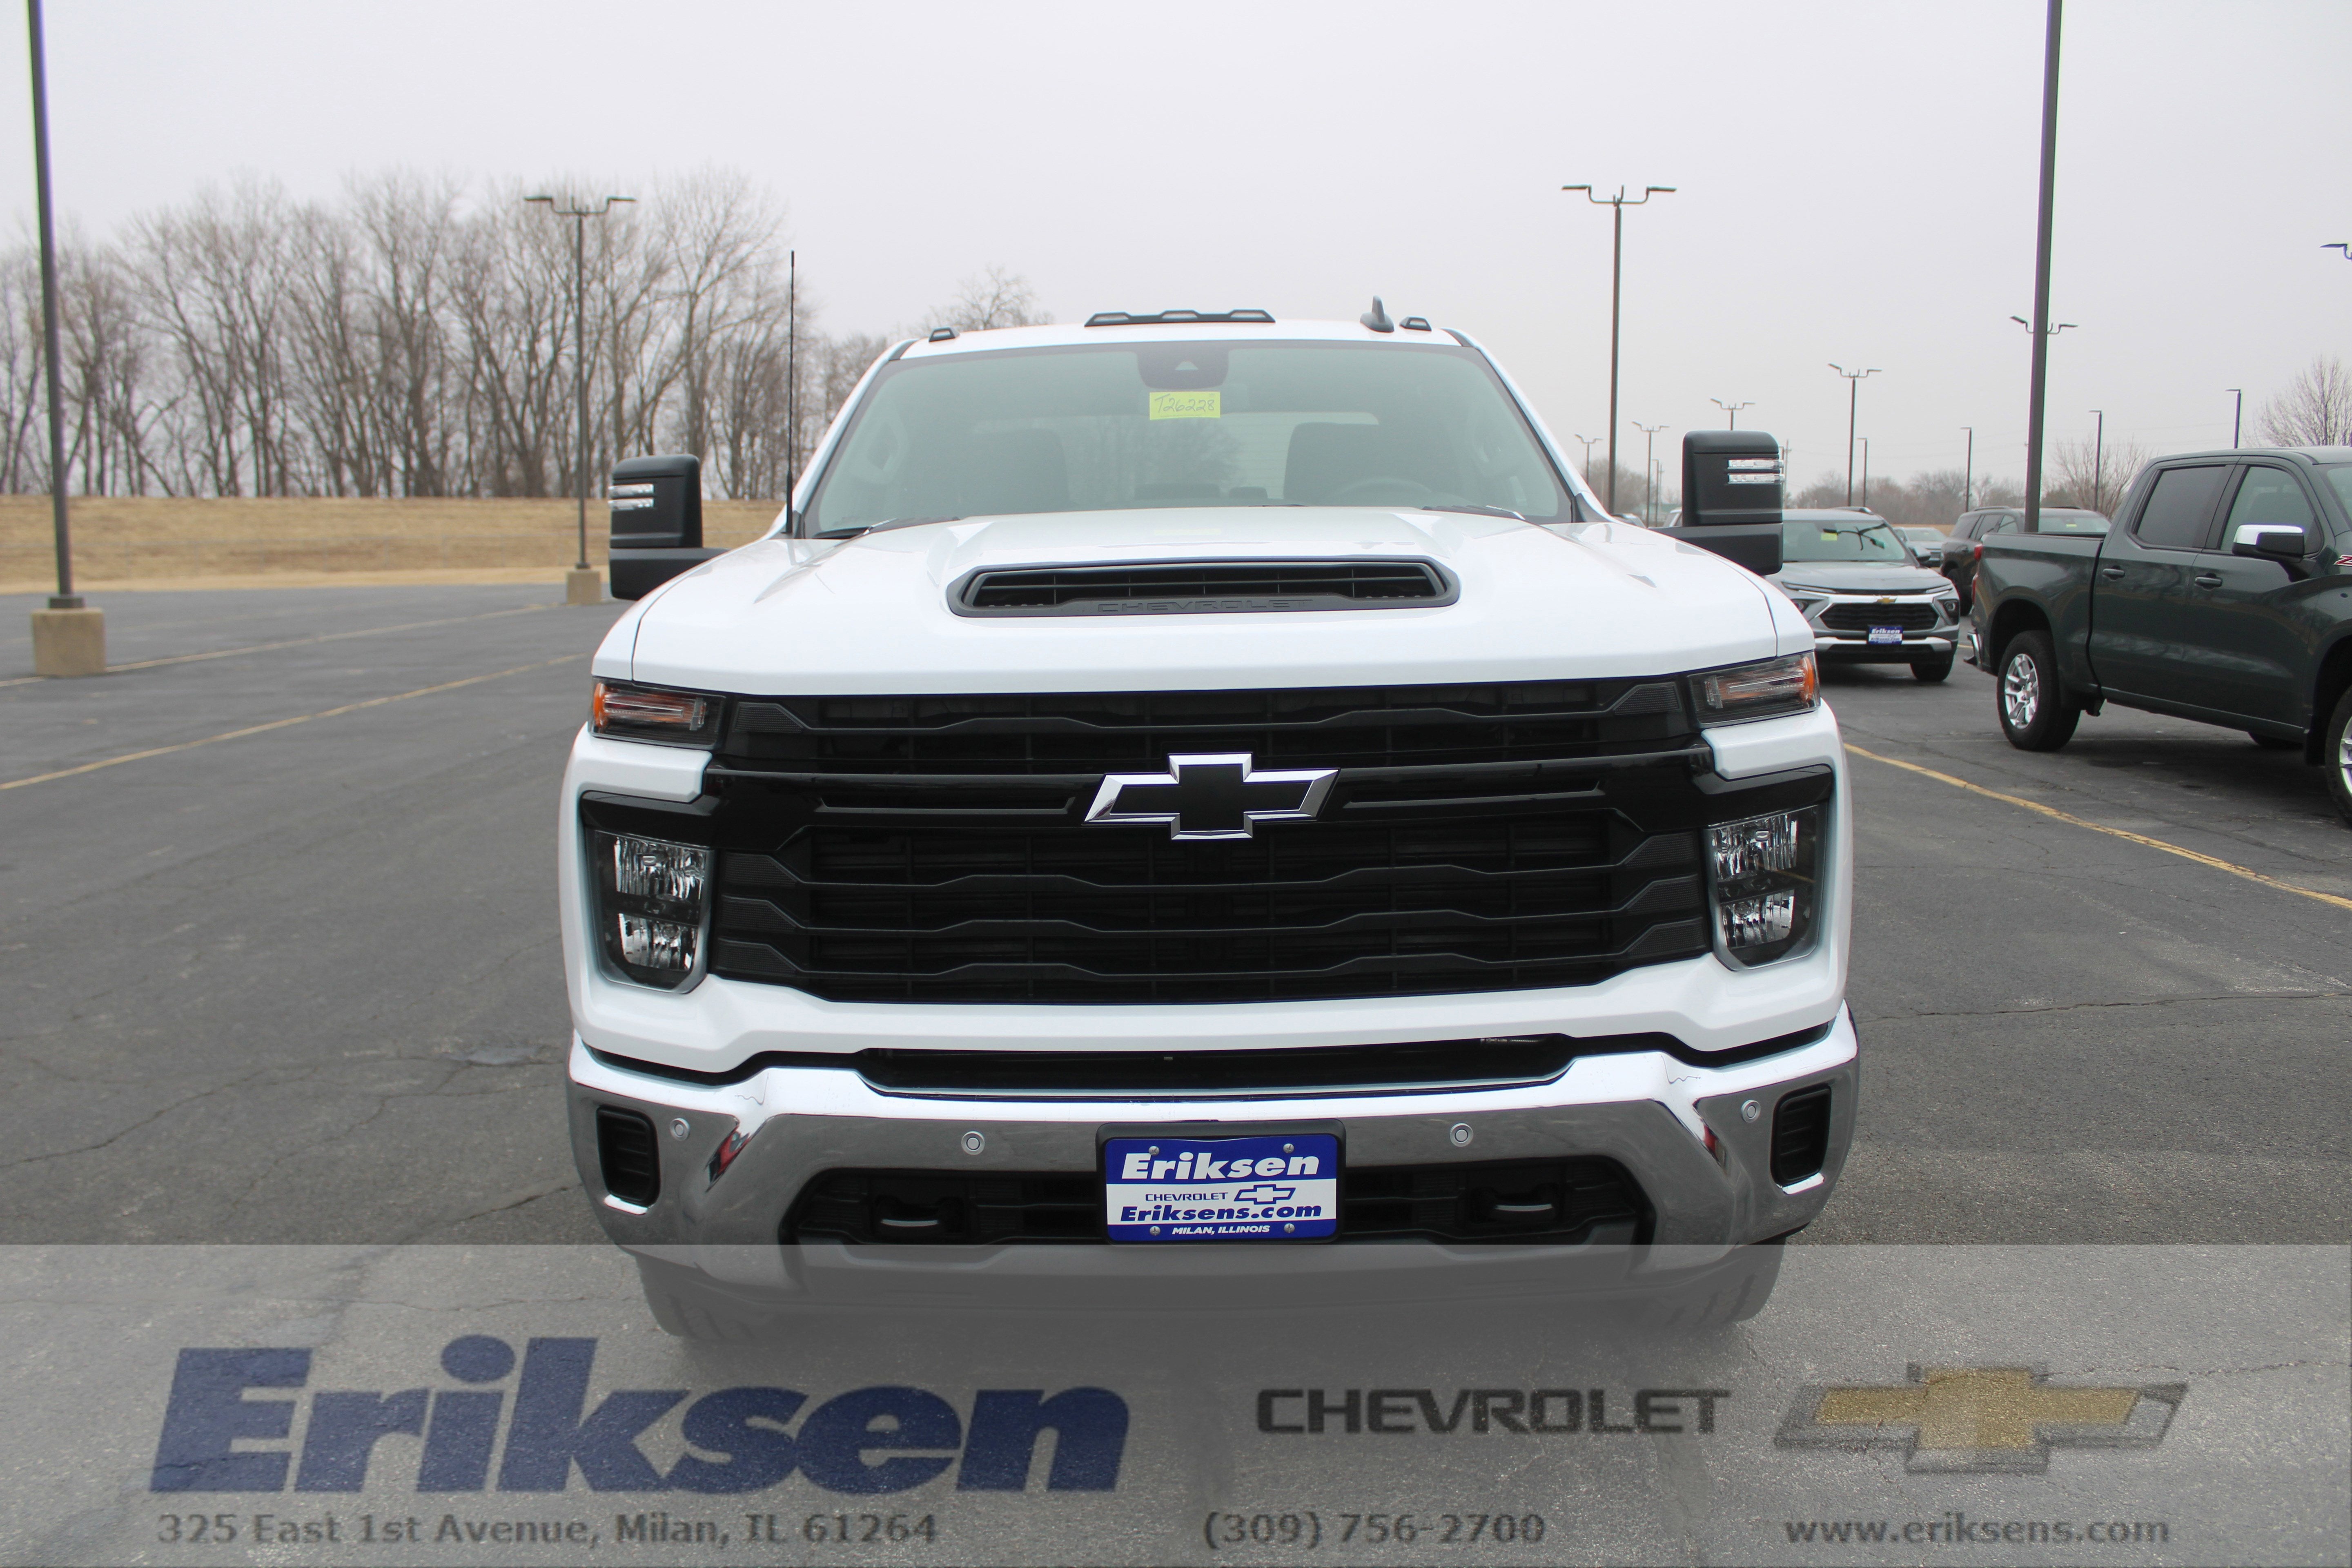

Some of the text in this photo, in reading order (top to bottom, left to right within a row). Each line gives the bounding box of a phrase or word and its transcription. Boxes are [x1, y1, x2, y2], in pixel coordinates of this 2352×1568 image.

[1155, 394, 1215, 413] T26228
[1098, 599, 1313, 612] CHEVROLET
[1121, 1152, 1319, 1180] Eriksen
[1145, 1192, 1229, 1202] CHEVROLET
[1120, 1205, 1322, 1222] Eriksens.com
[1172, 1225, 1270, 1235] MILAN, ILLINOIS
